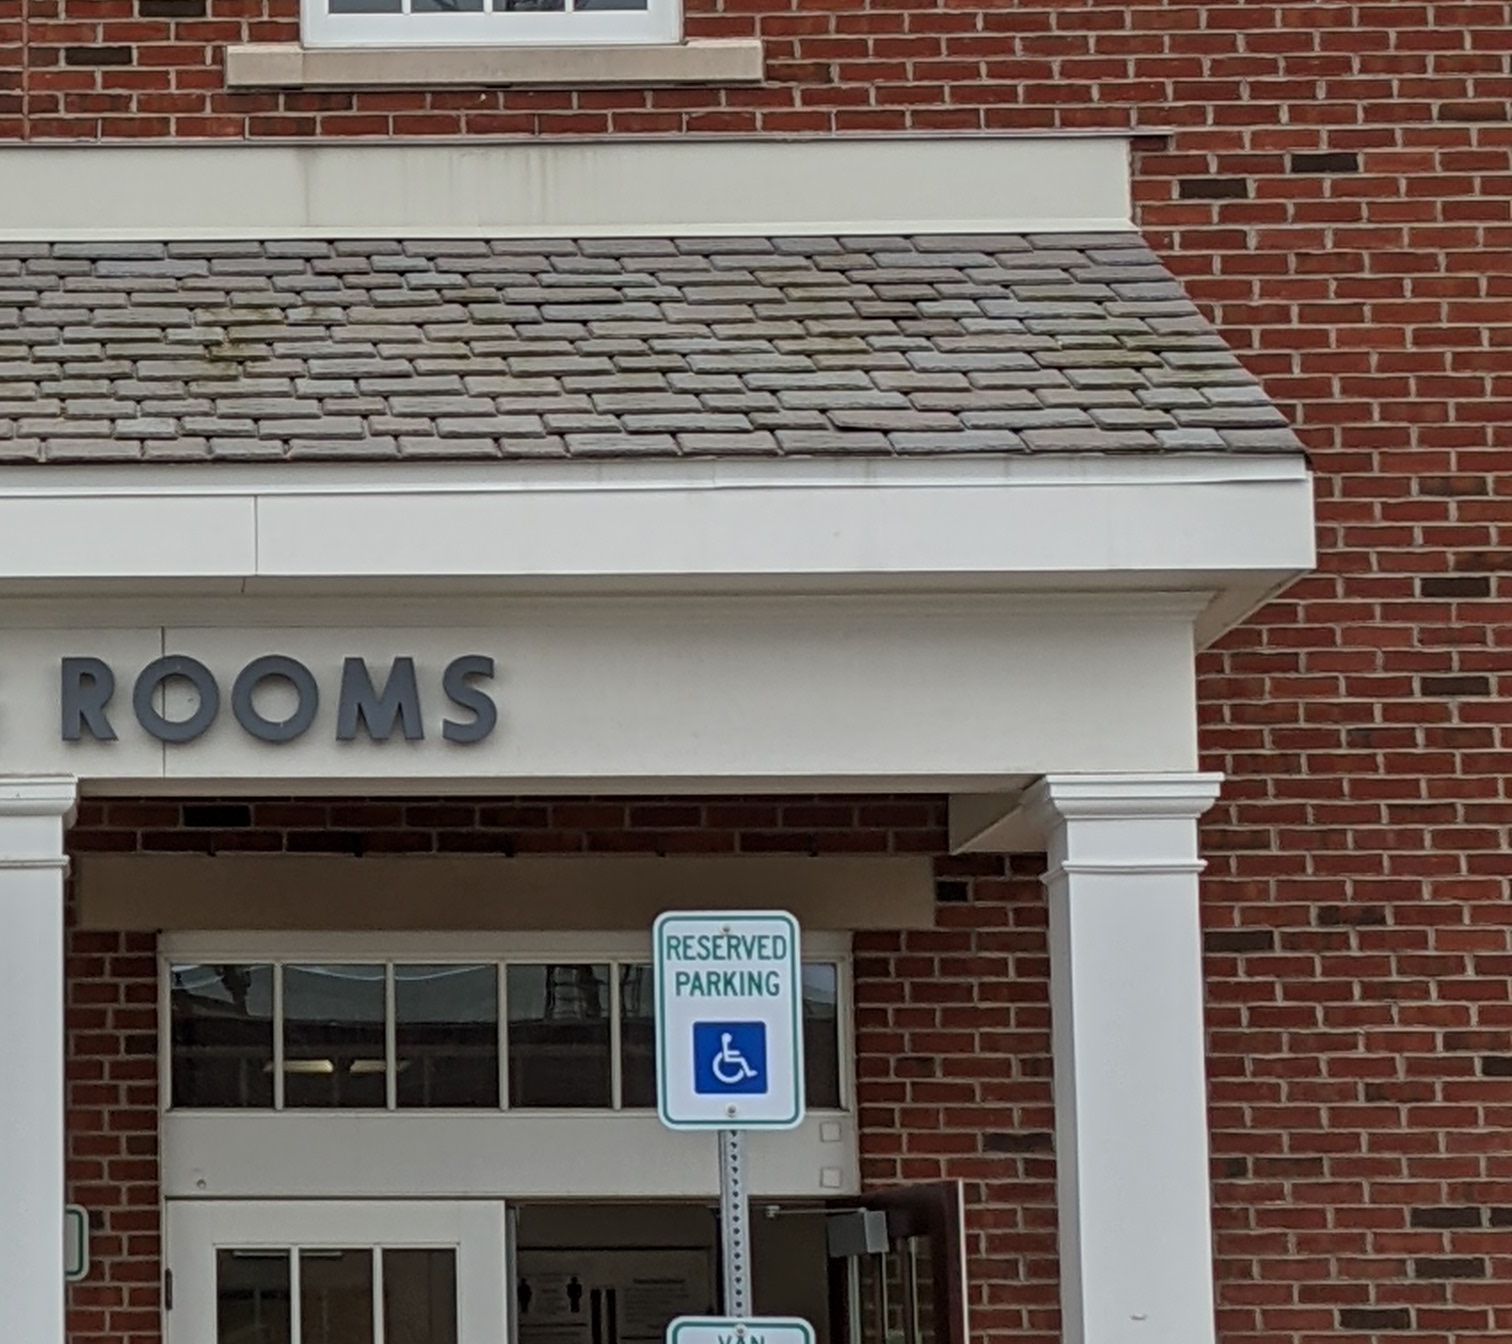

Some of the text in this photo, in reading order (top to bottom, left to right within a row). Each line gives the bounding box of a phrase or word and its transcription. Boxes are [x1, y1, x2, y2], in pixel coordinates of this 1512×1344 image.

[61, 654, 498, 746] ROOMS
[666, 935, 787, 961] RESERVED
[675, 970, 780, 997] PARKING
